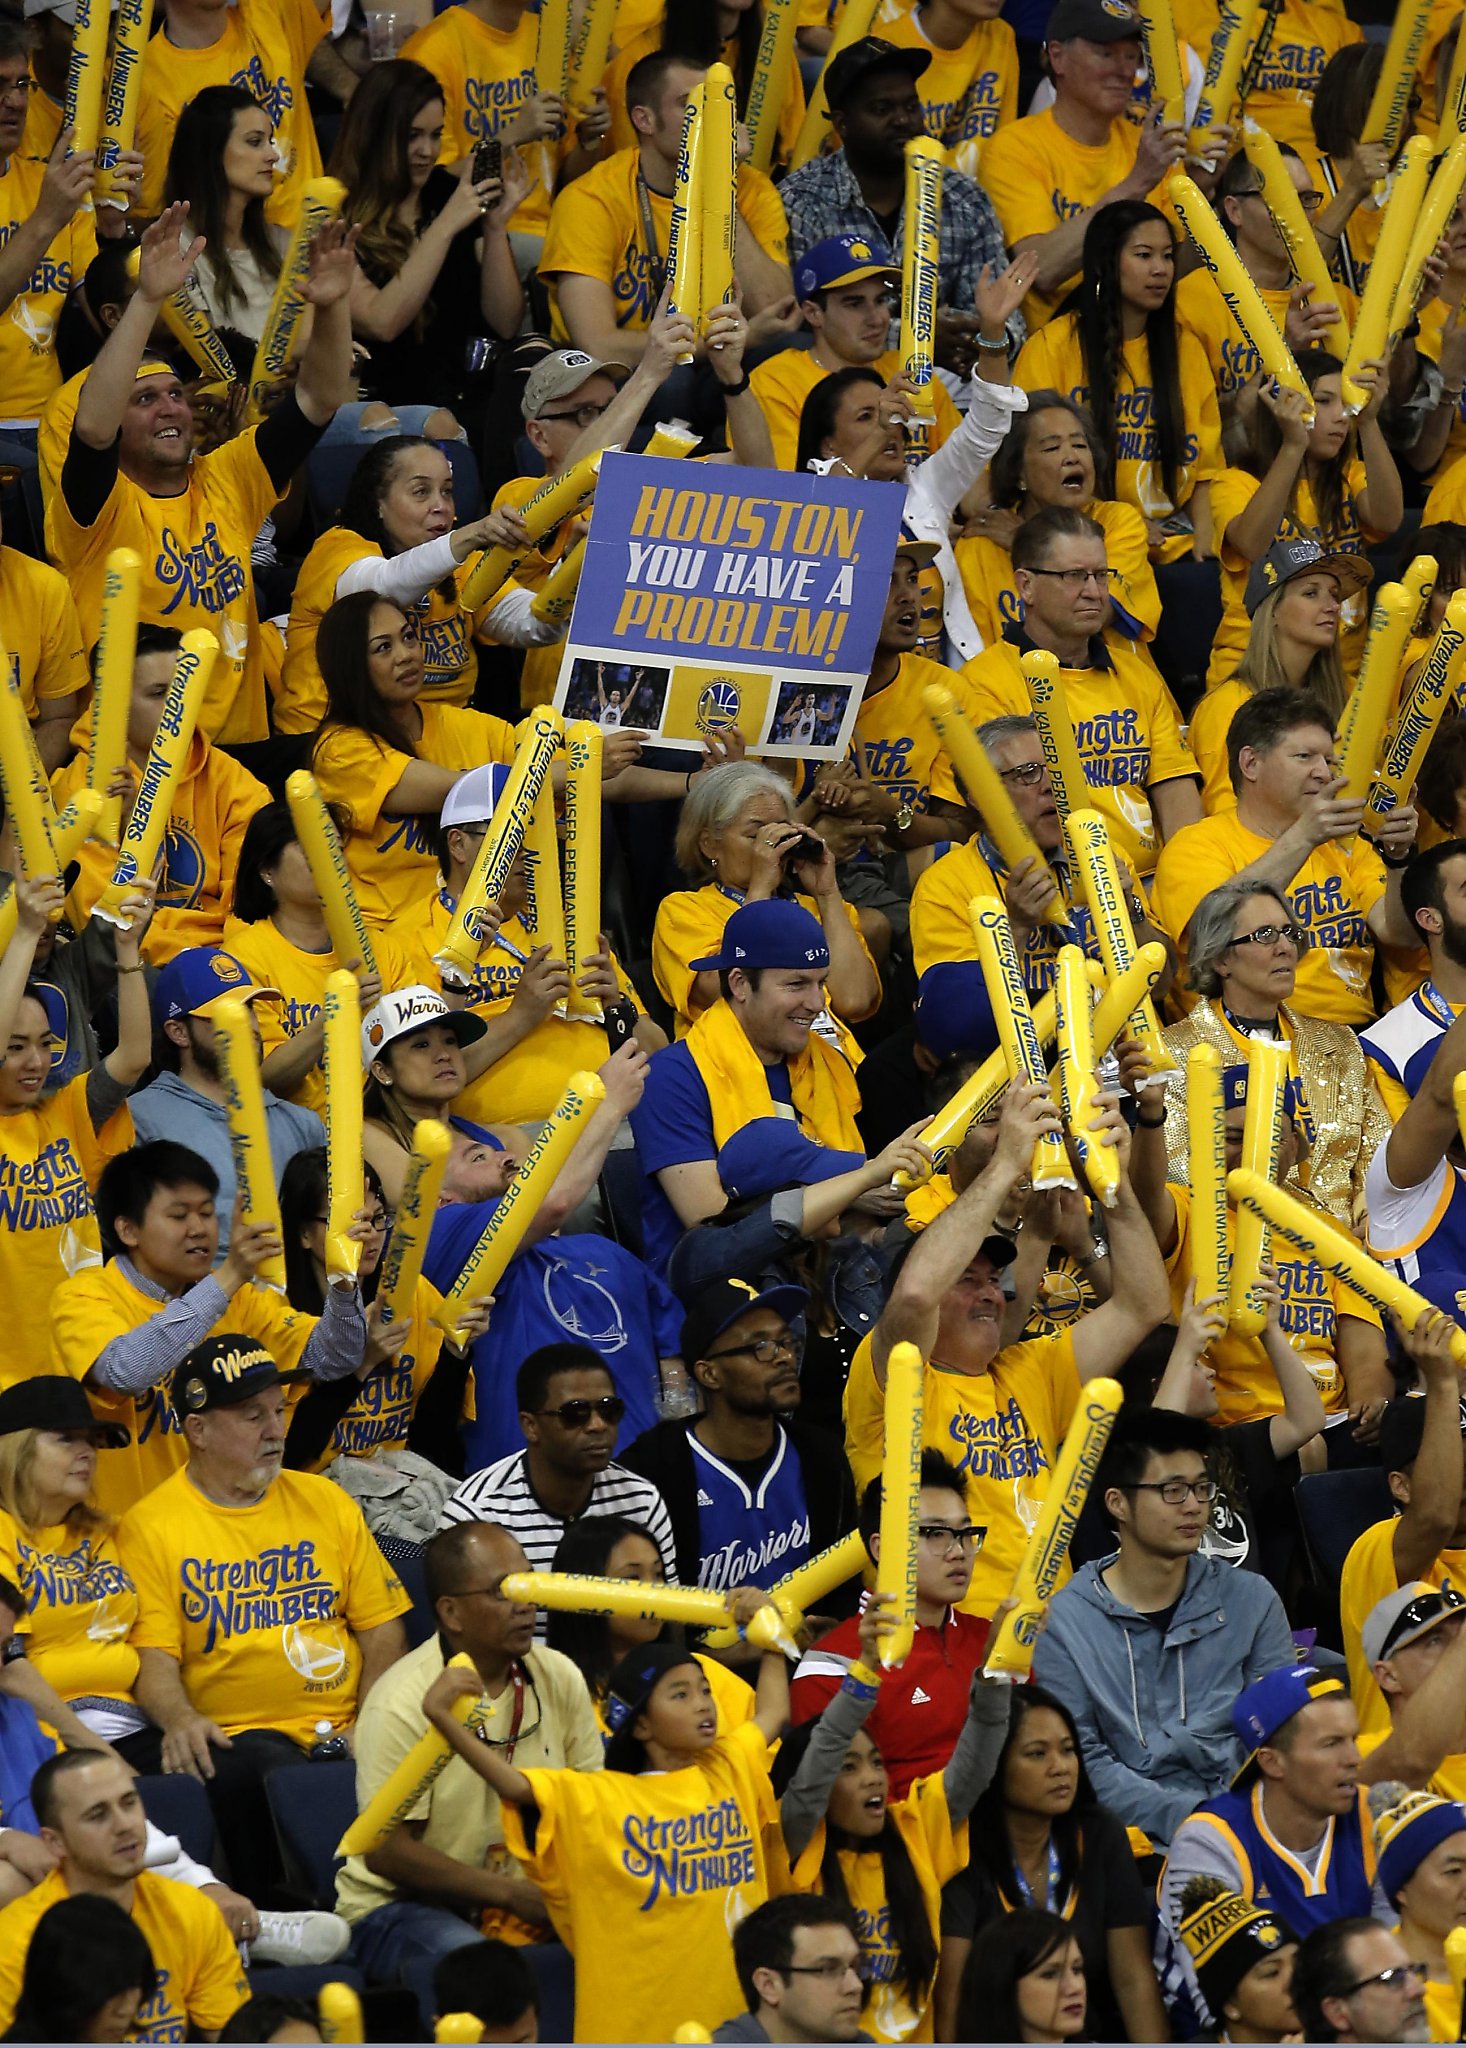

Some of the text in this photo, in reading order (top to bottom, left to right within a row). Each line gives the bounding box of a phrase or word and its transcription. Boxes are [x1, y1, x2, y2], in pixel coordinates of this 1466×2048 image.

[117, 28, 132, 42] in
[757, 12, 781, 67] KAISER
[105, 38, 138, 127] NUMBERS
[912, 250, 937, 342] NUMBERS
[630, 485, 864, 564] HOUSTON,
[626, 542, 855, 606] YOU HAVE A
[613, 589, 850, 666] PROBLEM!
[1412, 618, 1465, 703] Strength
[127, 644, 200, 843] Strength in NUMBERS
[1035, 710, 1059, 768] KAISER
[1387, 698, 1432, 780] NUMBERS
[522, 847, 541, 935] NUMBERS
[564, 780, 578, 974] KAISER PERMANENTE
[1089, 855, 1117, 914] KAISER
[979, 911, 1022, 997] Strength
[1211, 1106, 1224, 1169] KAISER
[452, 1123, 559, 1298] KAISER PERMANENTE
[903, 1407, 921, 1619] KAISER PERMANENTE
[1037, 1504, 1079, 1600] NUMBERS
[1213, 1506, 1234, 1529] 30
[180, 1540, 321, 1624] Strength
[697, 1514, 809, 1596] Warriors
[640, 1843, 756, 1912] NUMBE
